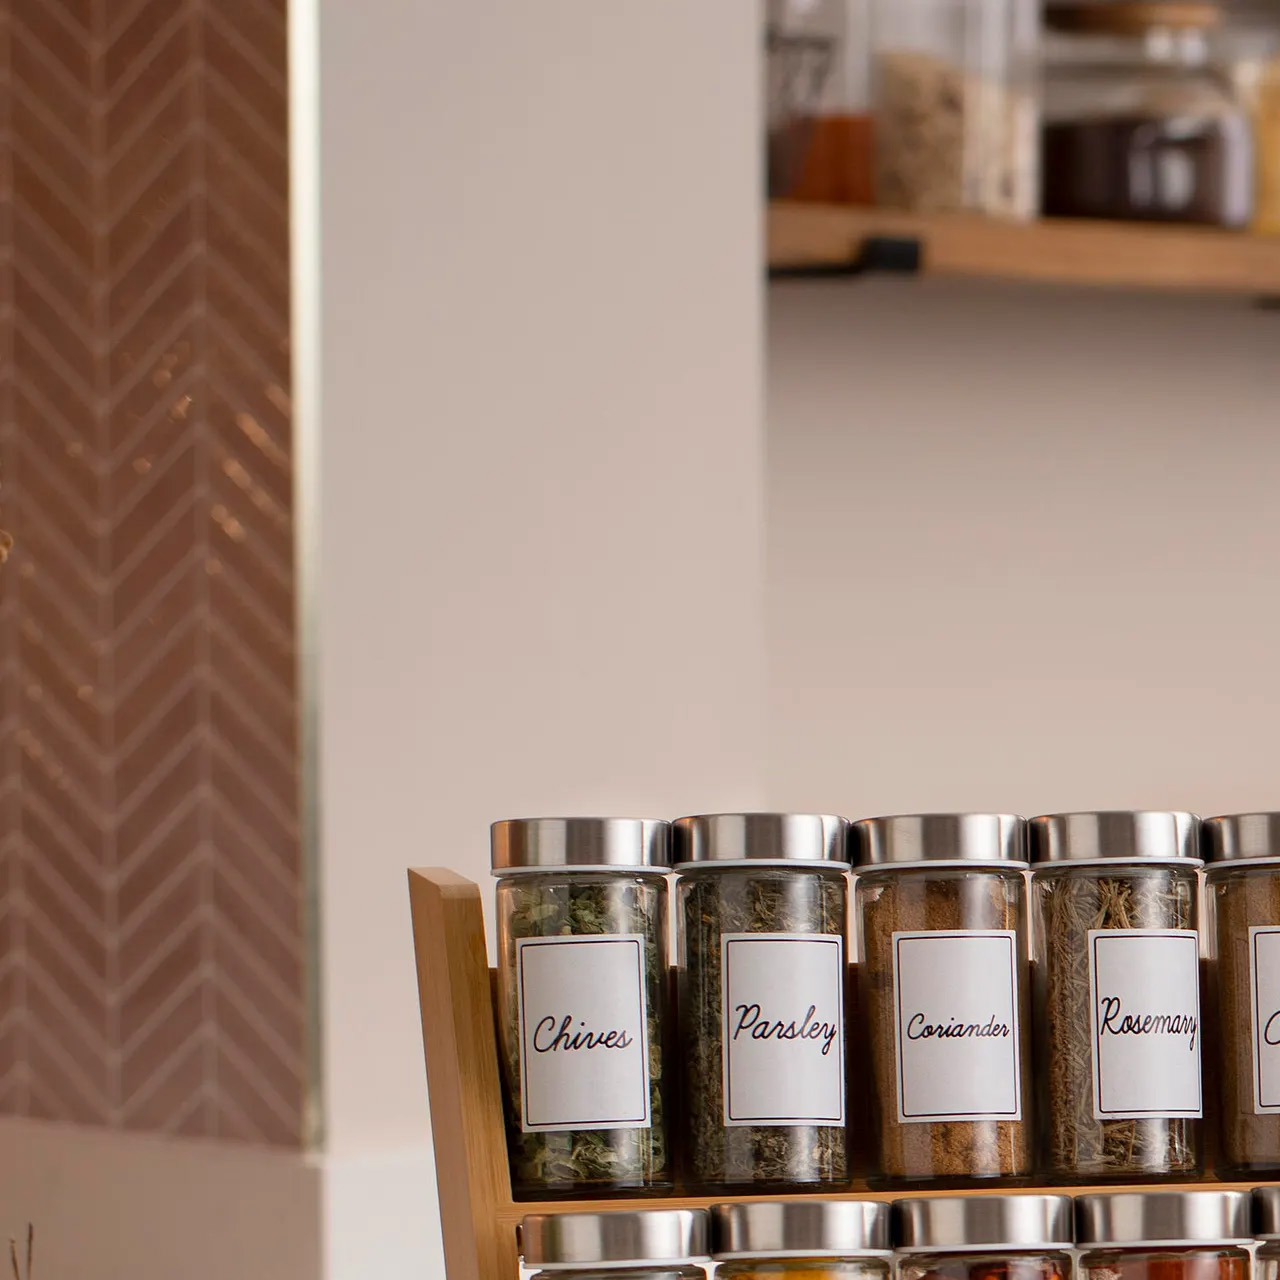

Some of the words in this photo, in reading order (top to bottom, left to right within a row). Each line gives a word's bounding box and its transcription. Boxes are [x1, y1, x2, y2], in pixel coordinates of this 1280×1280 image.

[533, 1015, 632, 1052] Chives
[733, 1004, 837, 1055] Parsley
[907, 1013, 1010, 1040] Coriander
[1100, 996, 1197, 1051] Rosemary
